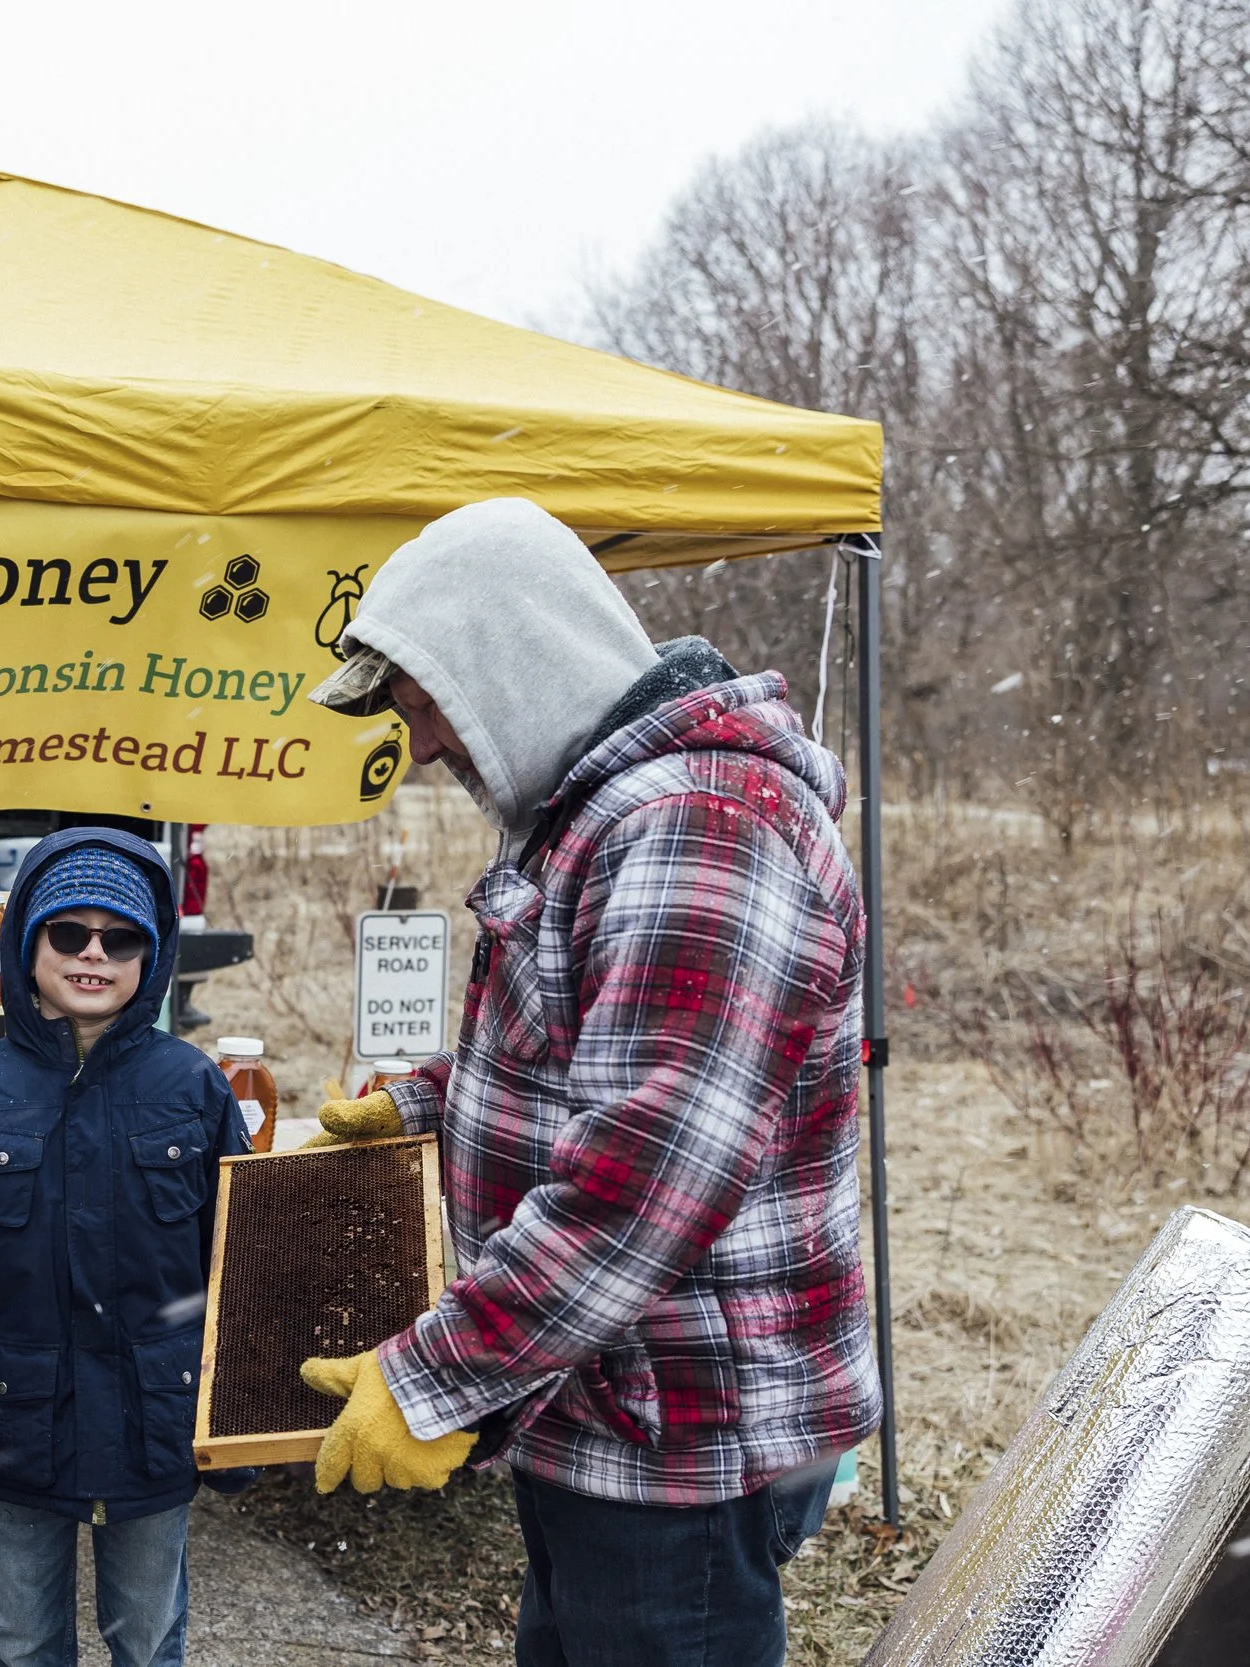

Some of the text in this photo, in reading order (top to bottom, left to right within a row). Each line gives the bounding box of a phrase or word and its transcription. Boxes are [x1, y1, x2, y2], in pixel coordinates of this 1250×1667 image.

[139, 653, 306, 716] Honey
[216, 737, 311, 782] LLC
[364, 935, 442, 951] SERVICE
[377, 958, 429, 973] ROAD
[367, 999, 435, 1015] DO NOT
[371, 1020, 431, 1037] ENTER
